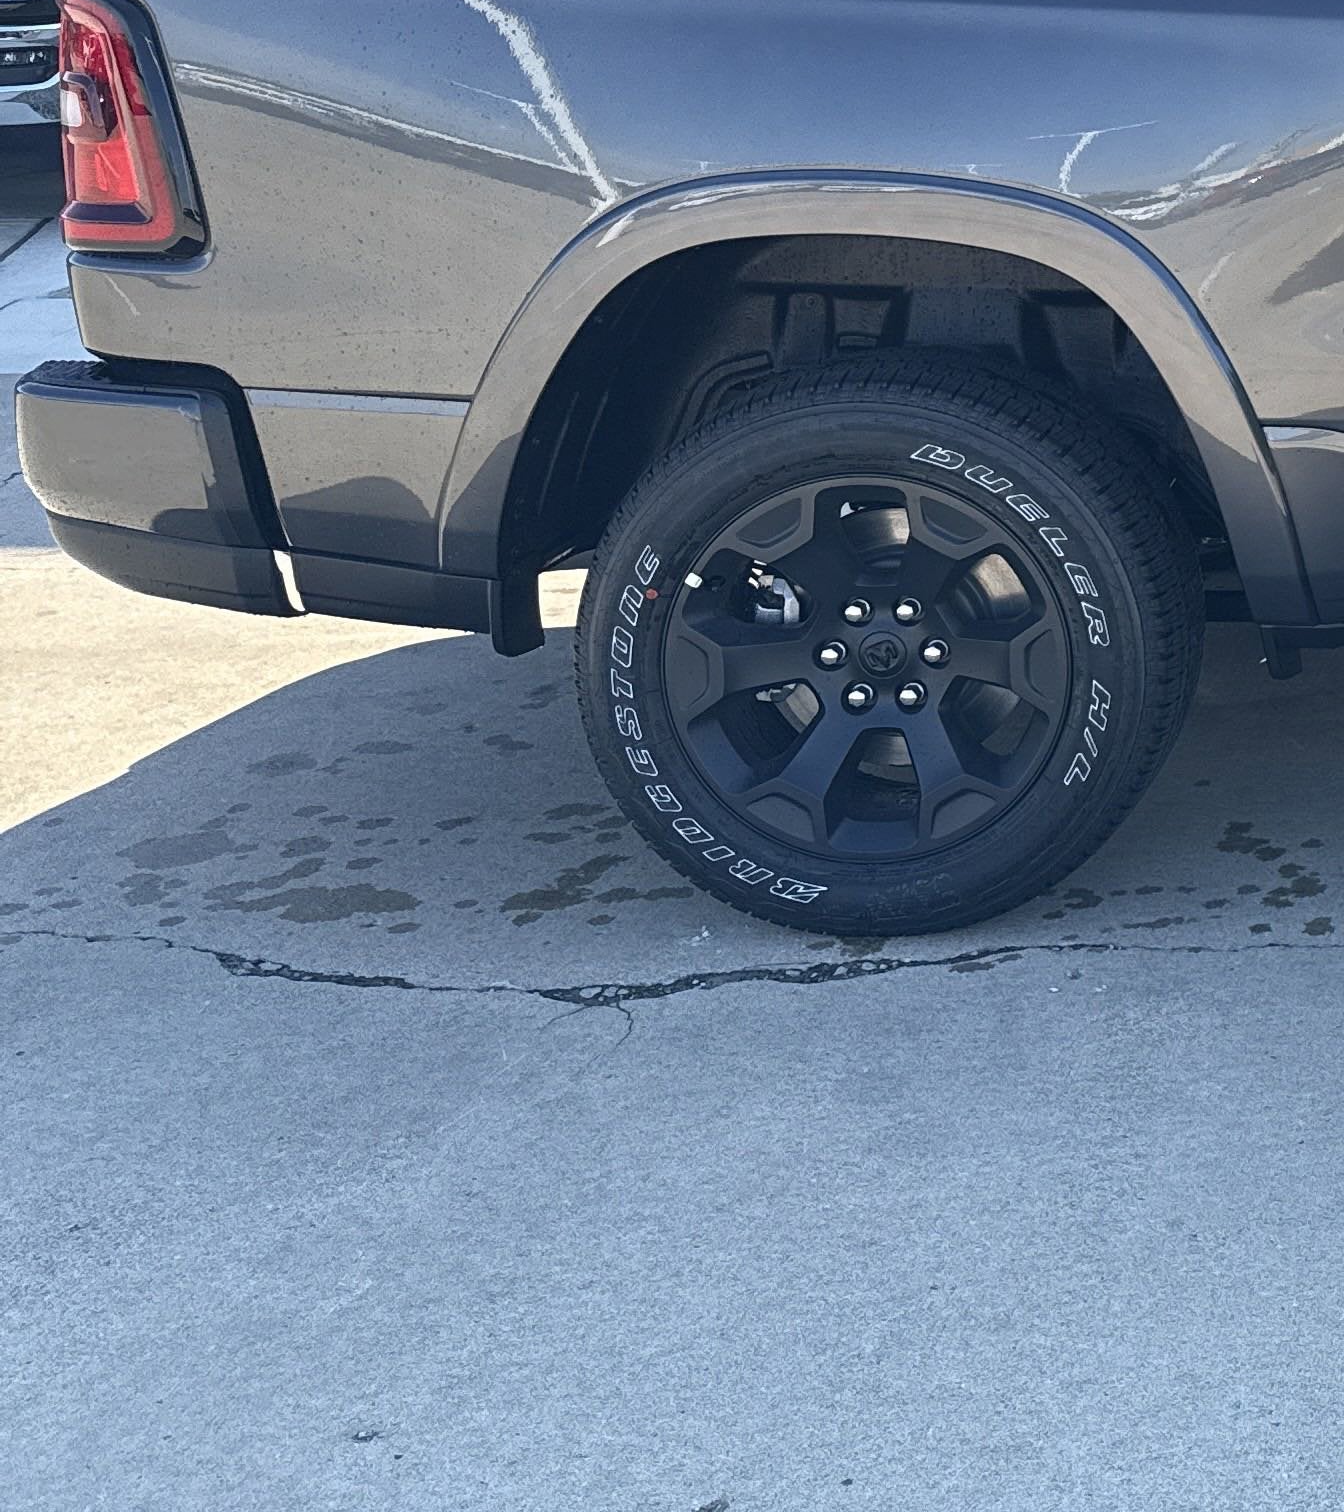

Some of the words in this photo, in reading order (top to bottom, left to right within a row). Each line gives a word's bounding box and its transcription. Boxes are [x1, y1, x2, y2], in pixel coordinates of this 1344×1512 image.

[610, 544, 829, 905] BRIDGESTONE
[909, 443, 1112, 648] DUELER
[1063, 680, 1112, 786] H/L
